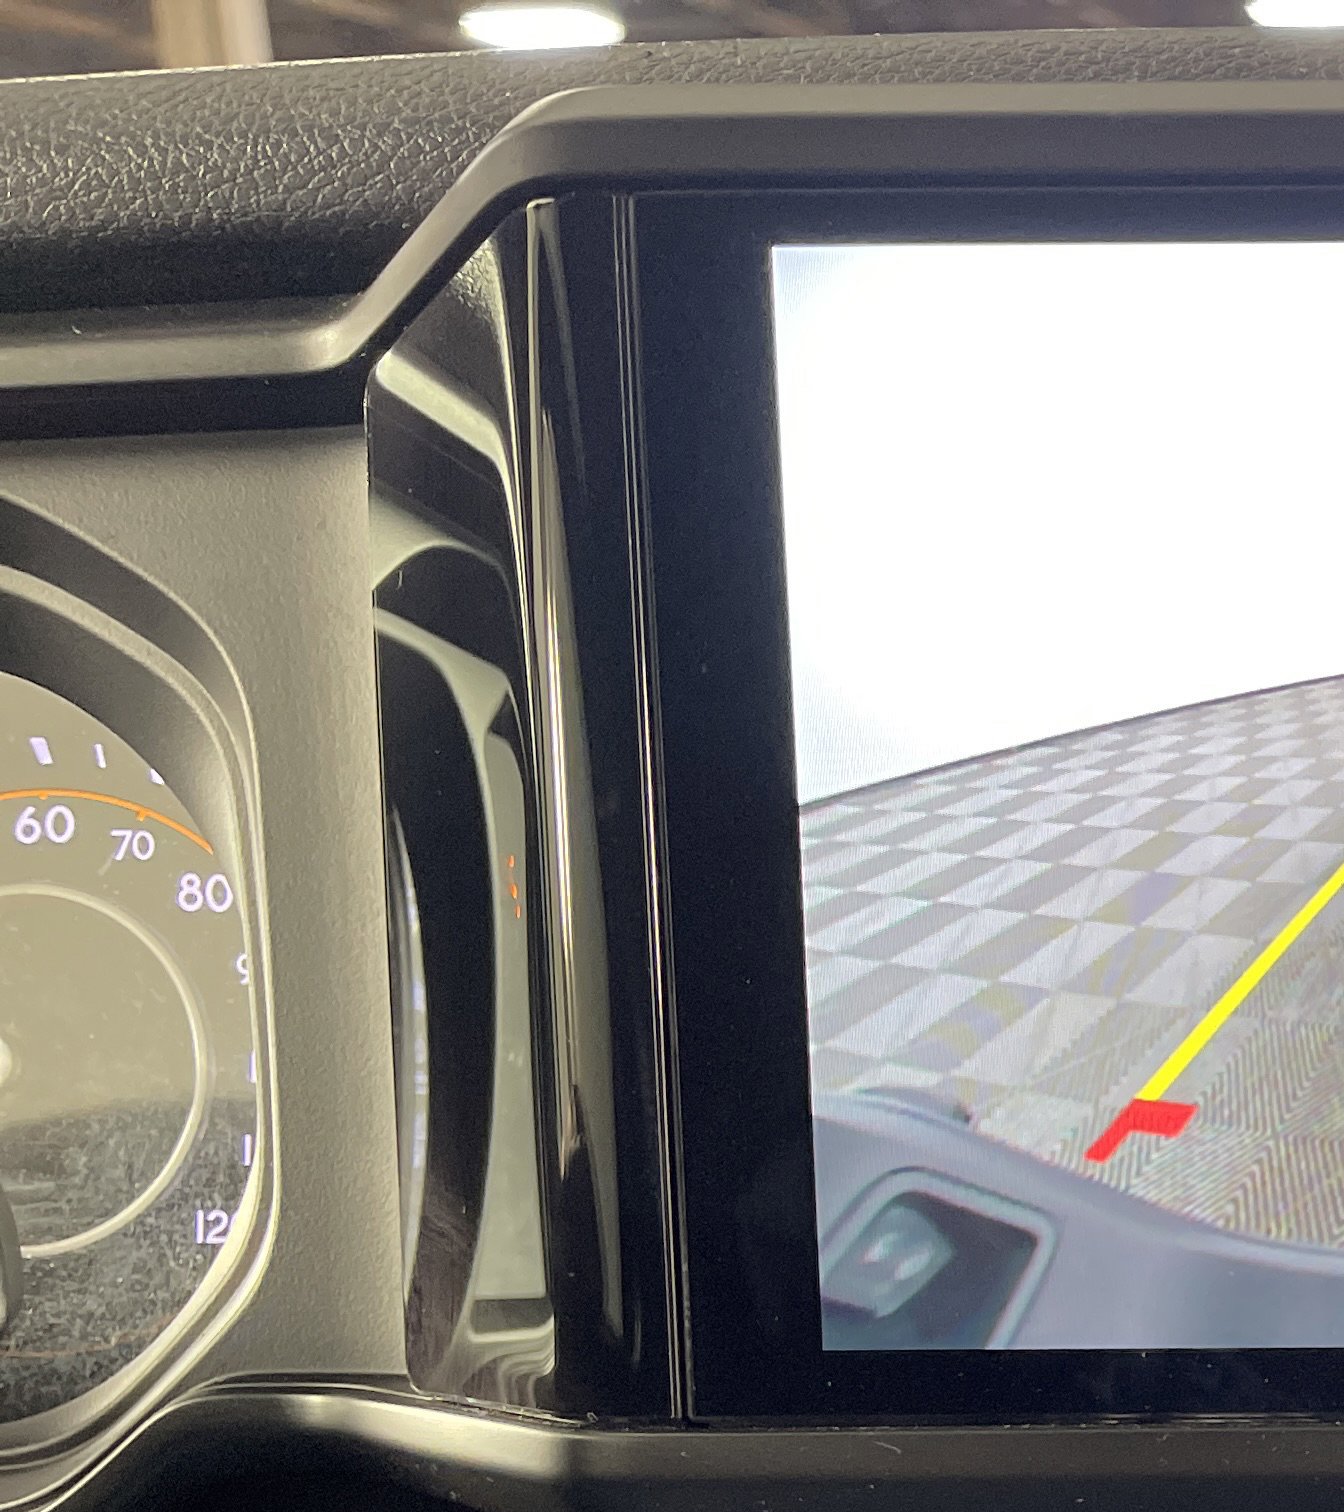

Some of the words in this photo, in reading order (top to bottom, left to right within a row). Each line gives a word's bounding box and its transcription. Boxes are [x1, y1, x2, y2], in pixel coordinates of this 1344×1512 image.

[14, 804, 76, 845] 60
[110, 829, 156, 861] 70
[176, 872, 234, 913] 80
[194, 1208, 236, 1245] 12
